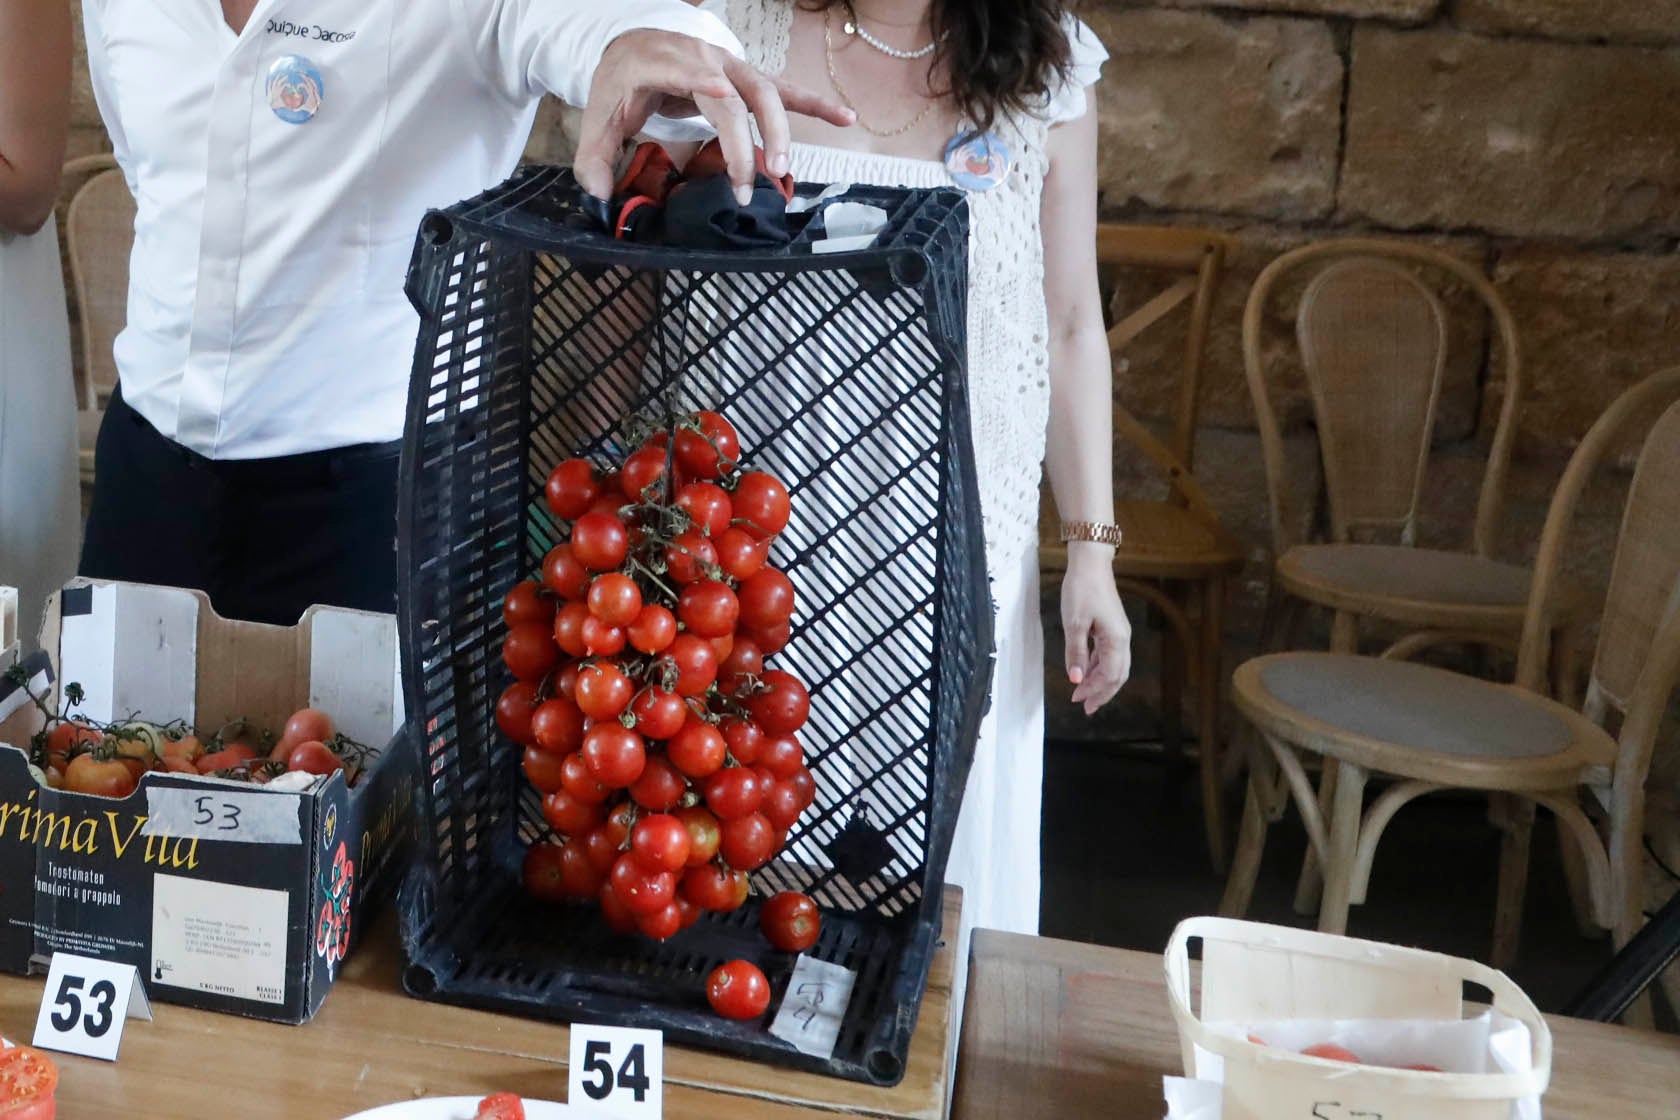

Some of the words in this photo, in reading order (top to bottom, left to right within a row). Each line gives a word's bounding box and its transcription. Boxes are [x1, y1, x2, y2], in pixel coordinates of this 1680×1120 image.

[194, 796, 241, 830] 53
[48, 861, 105, 886] Trostomaten
[82, 888, 121, 907] grappolo
[51, 974, 117, 1038] 53
[582, 1040, 650, 1102] 54
